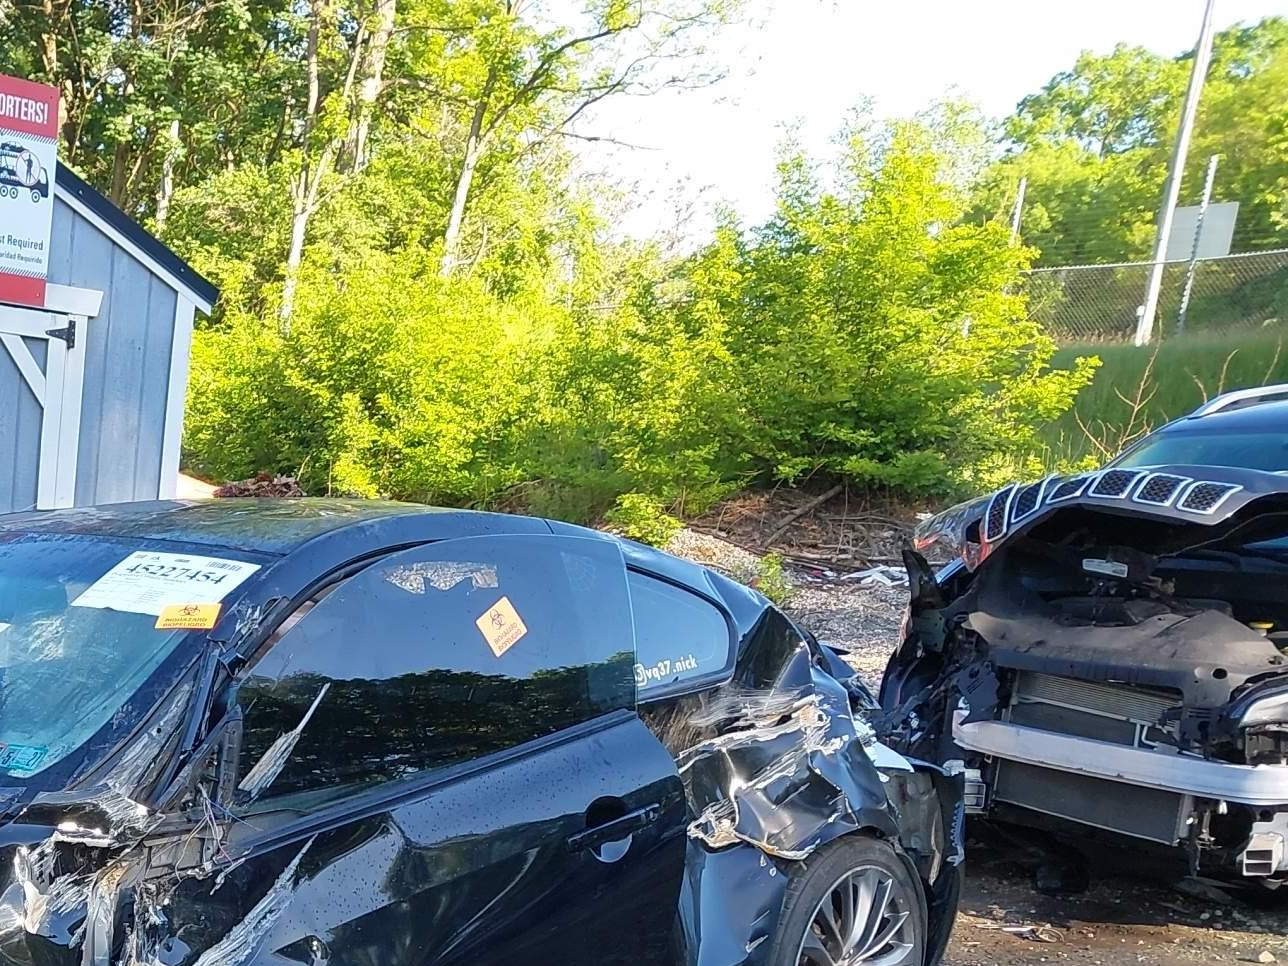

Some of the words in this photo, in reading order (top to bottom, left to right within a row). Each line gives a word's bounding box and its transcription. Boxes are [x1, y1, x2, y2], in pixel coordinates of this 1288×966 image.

[7, 235, 44, 251] Required
[126, 563, 228, 585] 45227454
[645, 654, 698, 681] vq37.nick
